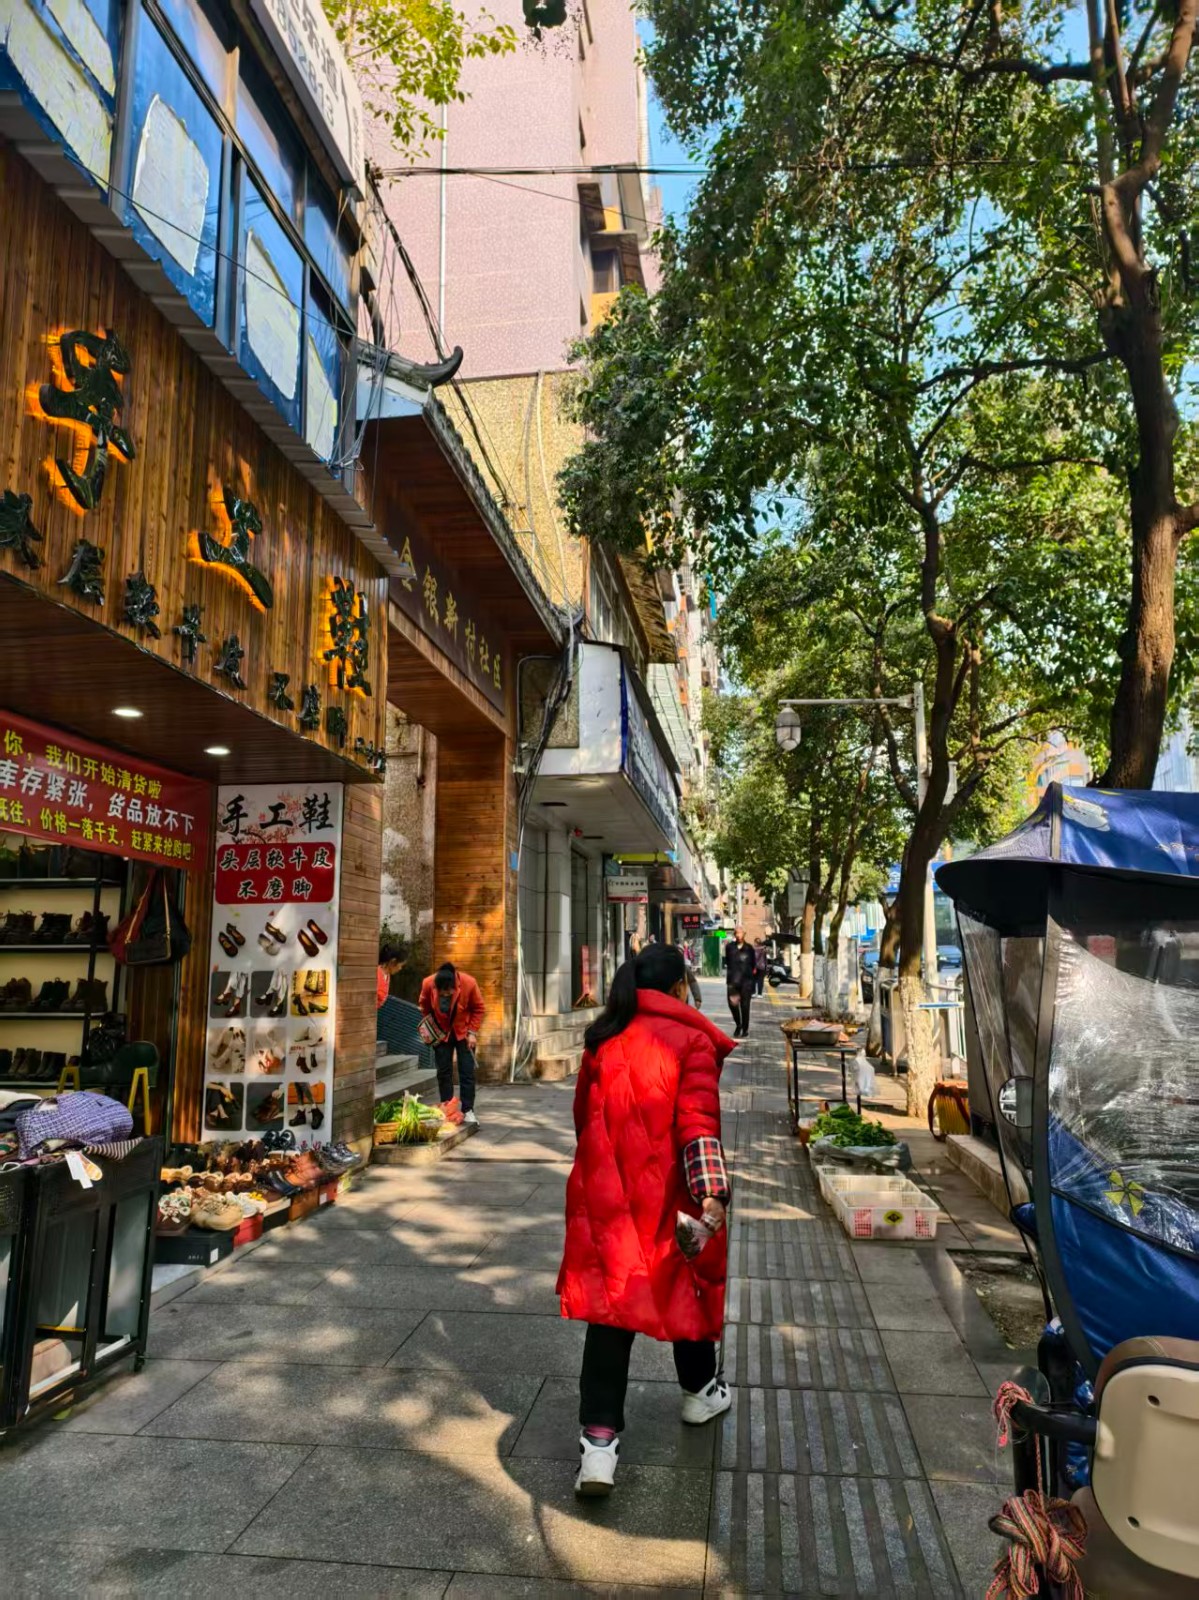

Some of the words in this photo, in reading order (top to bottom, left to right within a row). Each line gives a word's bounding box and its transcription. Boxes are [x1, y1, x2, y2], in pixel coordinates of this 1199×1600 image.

[37, 327, 372, 696] 手工鞋
[222, 792, 335, 837] 手工鞋
[219, 845, 334, 872] 头层软牛皮
[237, 876, 313, 901] 不磨脚
